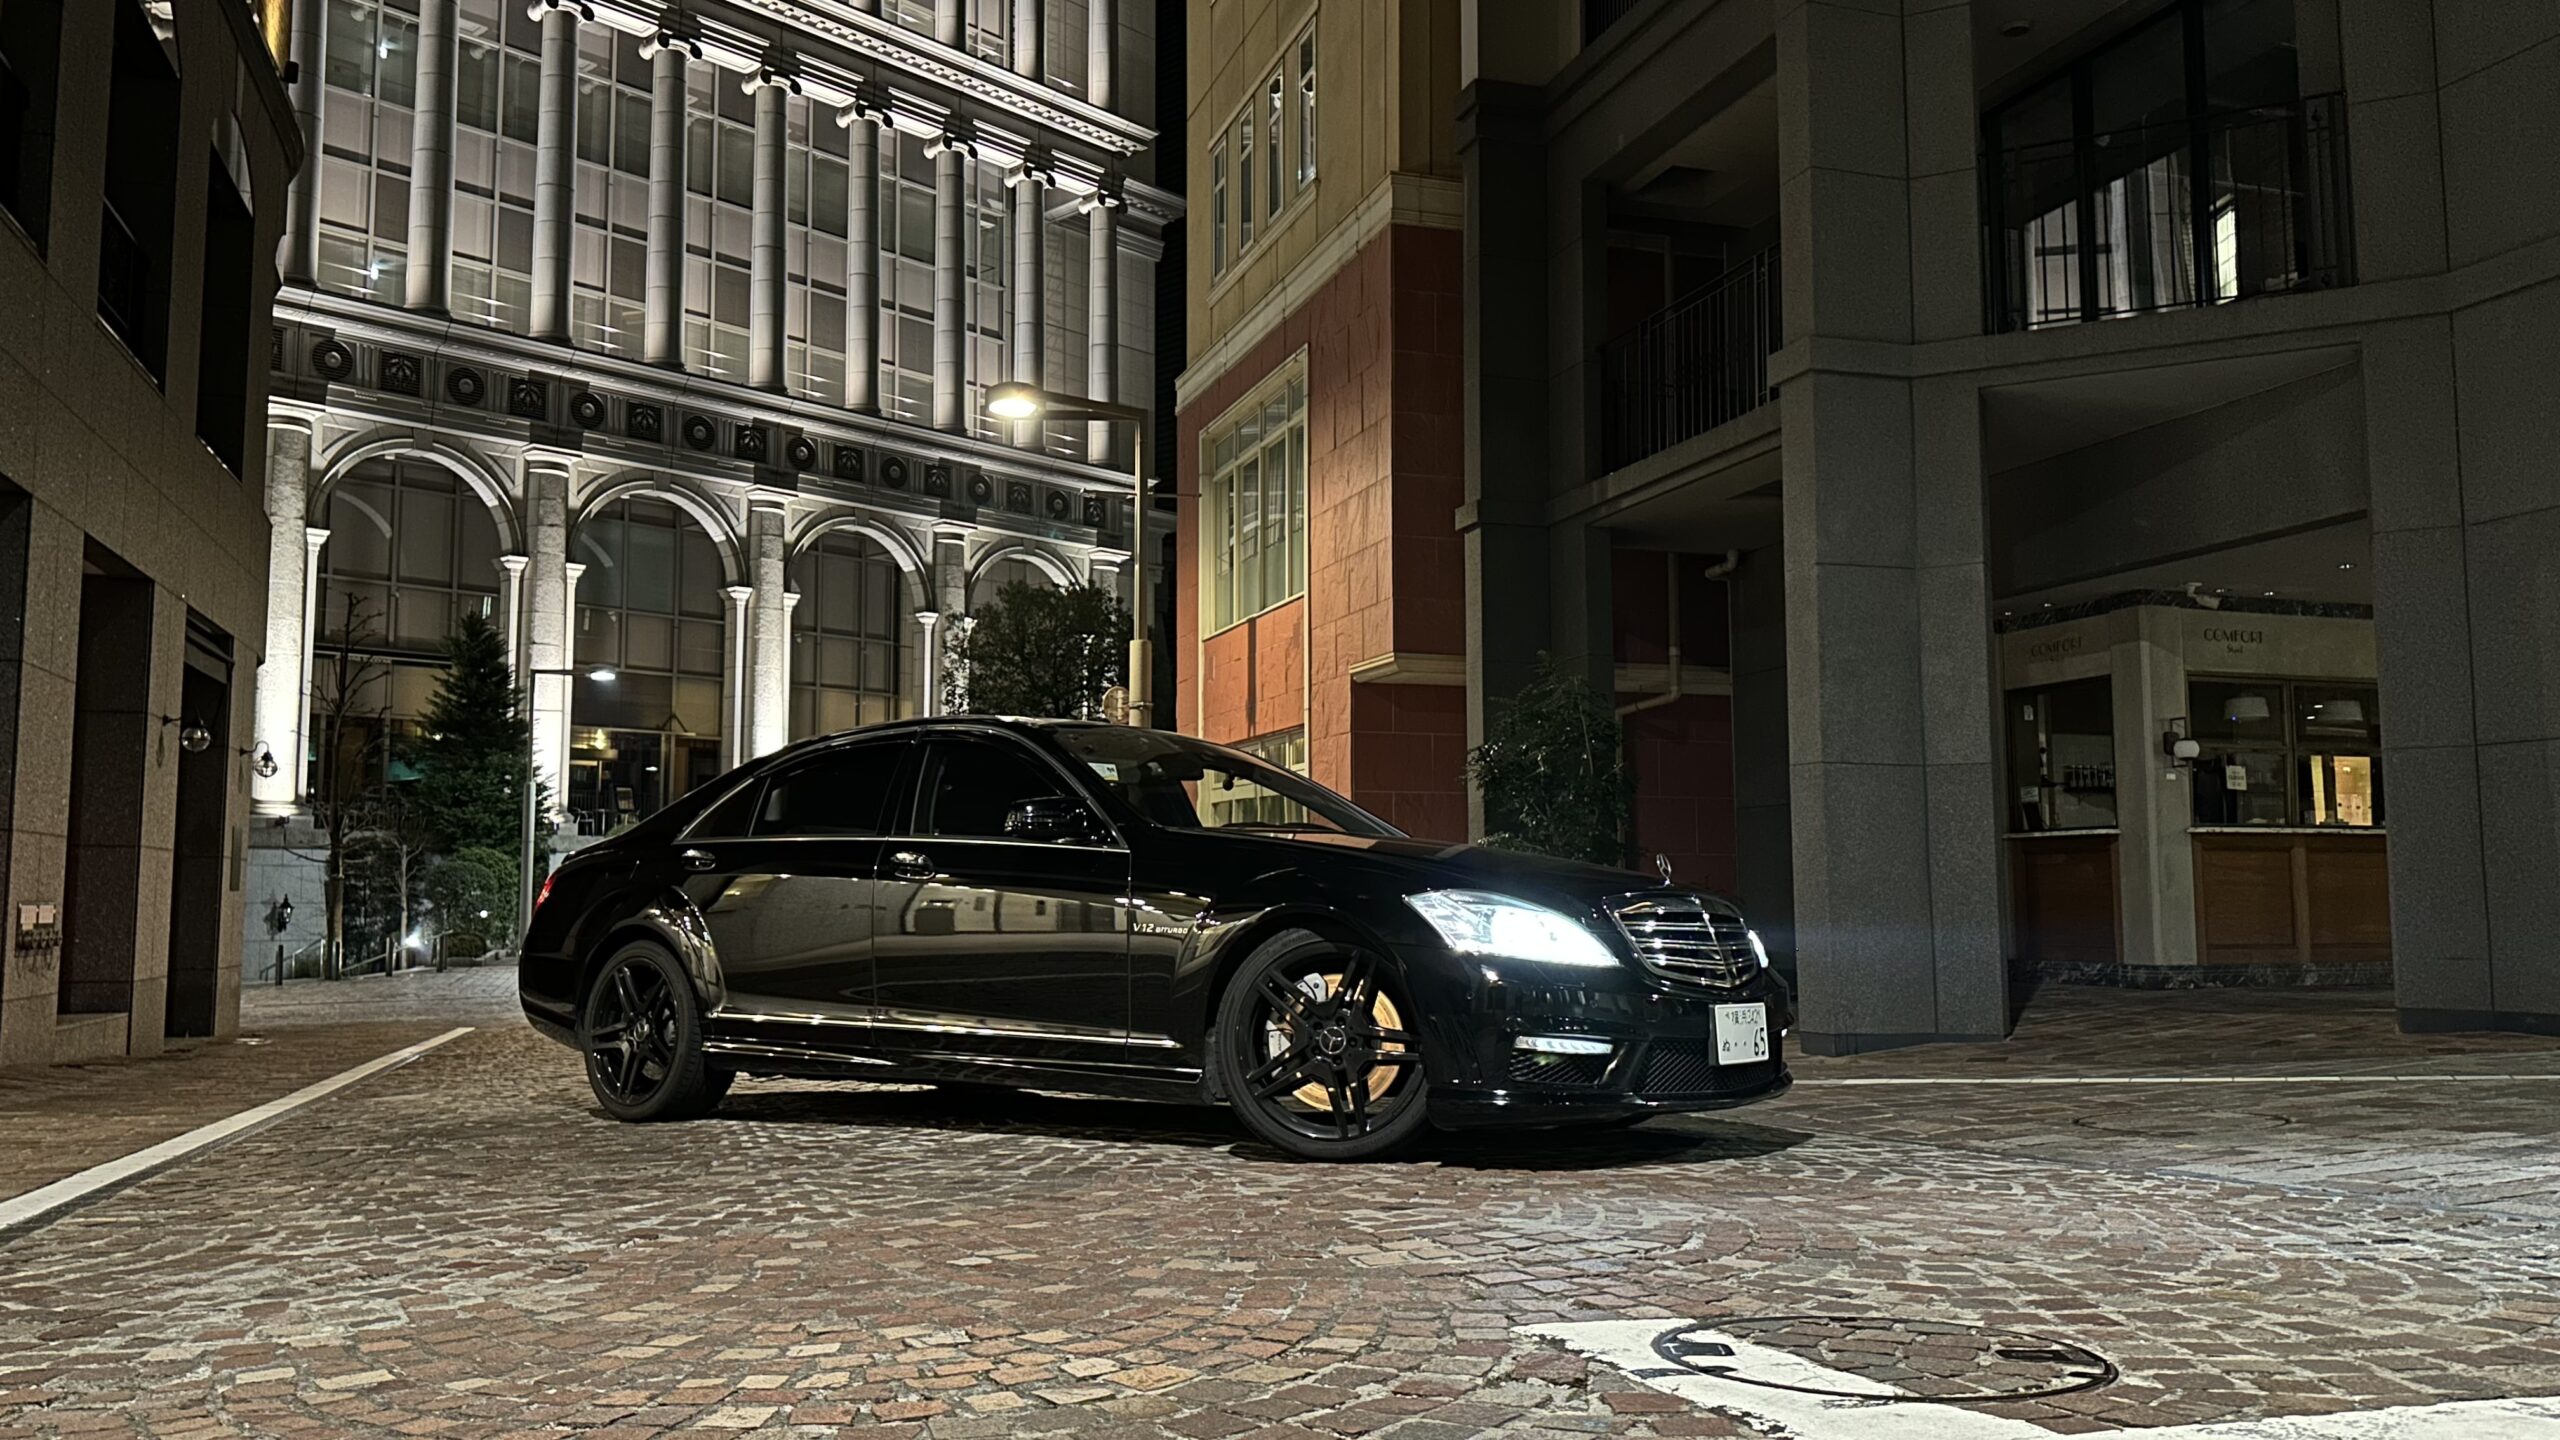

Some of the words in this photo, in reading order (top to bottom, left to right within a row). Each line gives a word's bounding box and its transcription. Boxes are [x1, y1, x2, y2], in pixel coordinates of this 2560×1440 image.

[2203, 628, 2263, 643] COMFORT
[1132, 922, 1154, 933] V12
[1155, 926, 1188, 934] BITURBO
